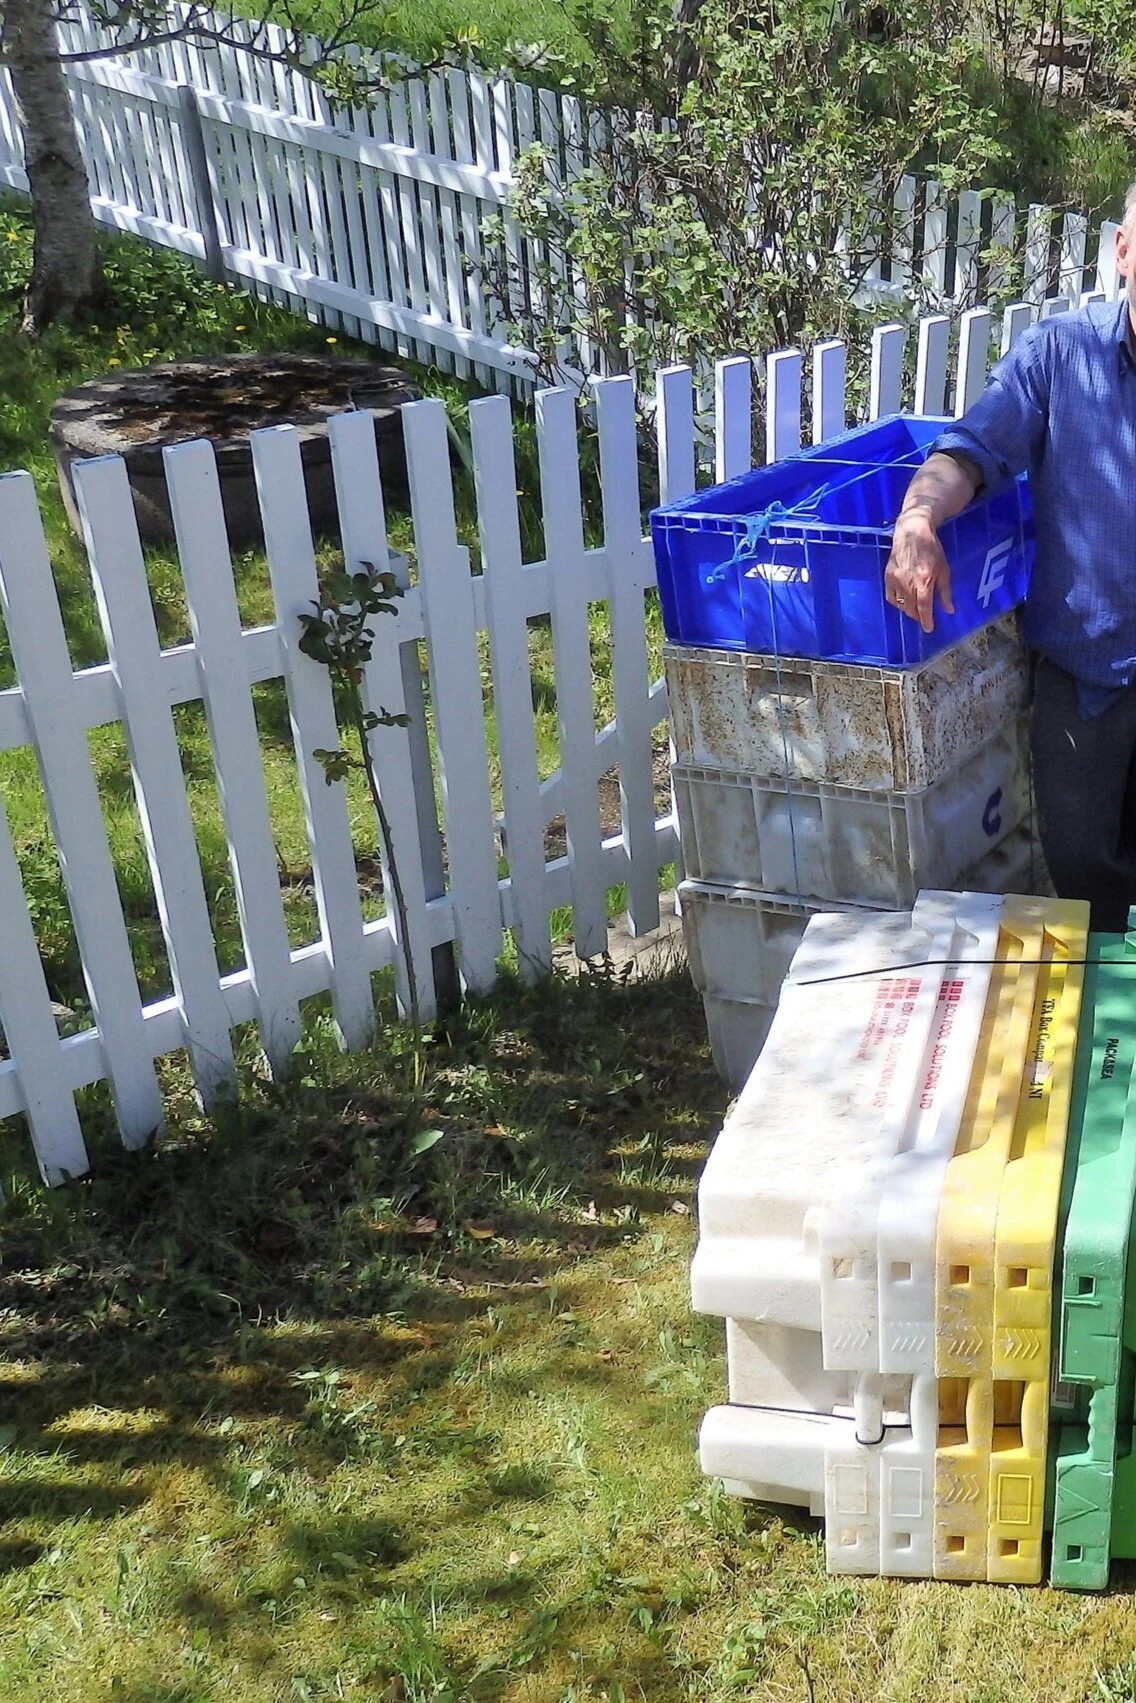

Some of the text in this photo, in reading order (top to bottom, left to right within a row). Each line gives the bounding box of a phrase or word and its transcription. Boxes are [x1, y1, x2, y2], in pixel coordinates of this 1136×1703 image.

[902, 1001, 915, 1019] BOX
[1039, 1016, 1053, 1032] Box
[919, 1003, 957, 1110] BOX POOL SOLUTIONS LTD
